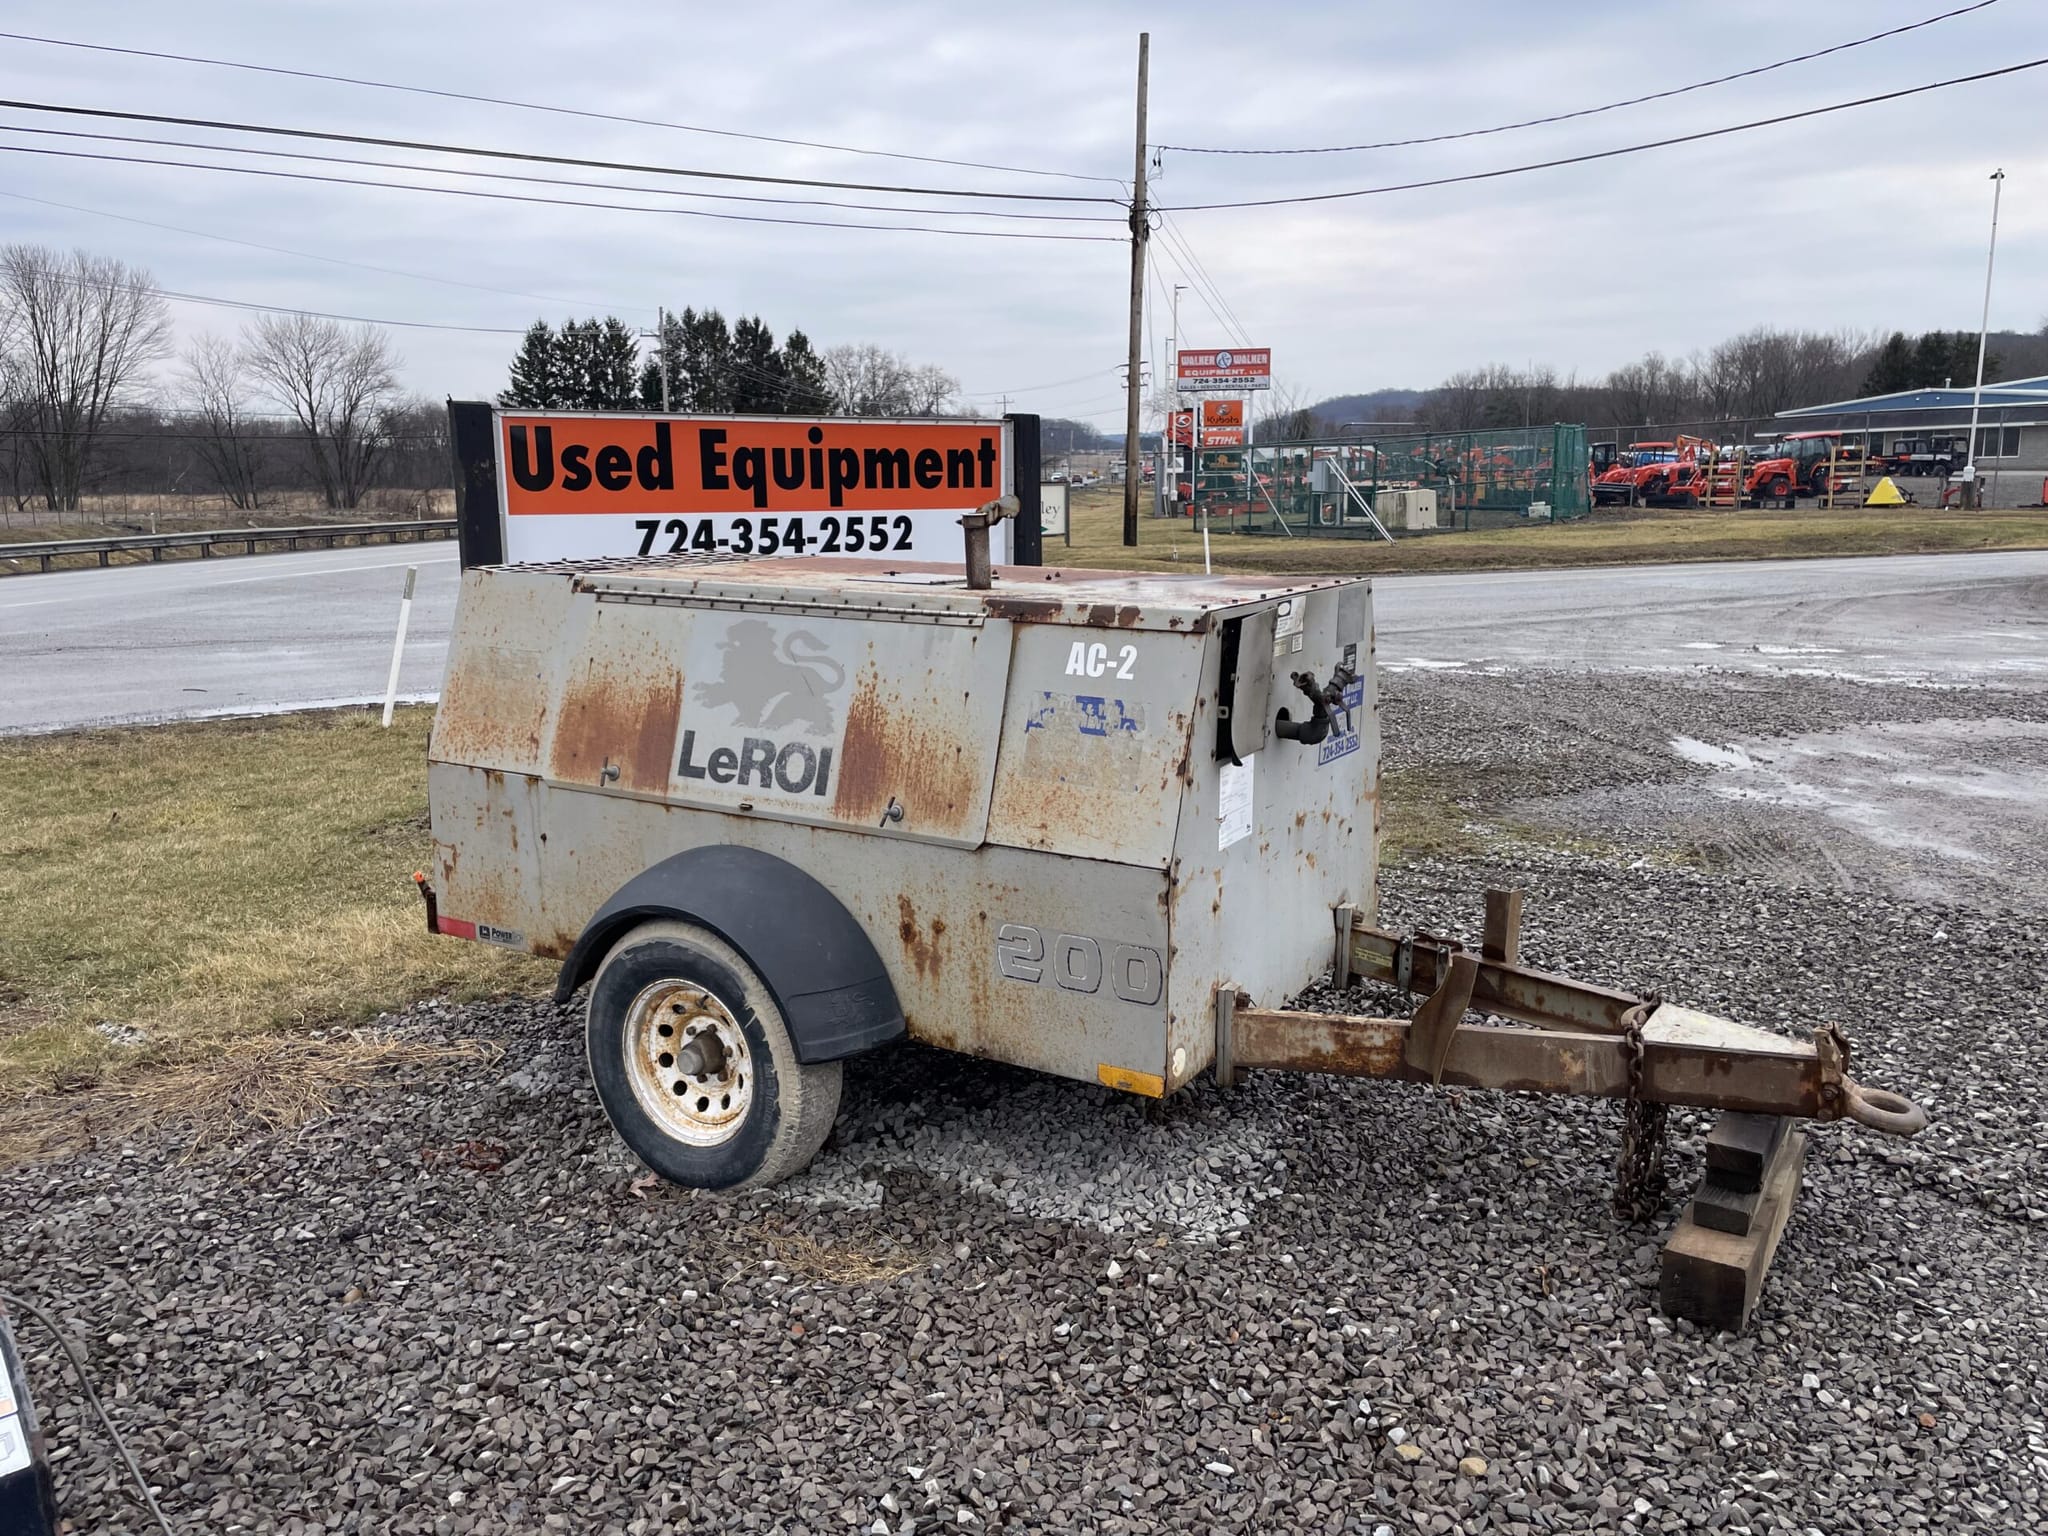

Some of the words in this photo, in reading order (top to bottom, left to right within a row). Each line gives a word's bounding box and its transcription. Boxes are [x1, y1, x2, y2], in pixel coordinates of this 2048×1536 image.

[1181, 355, 1215, 366] WALKER
[1217, 353, 1231, 368] &
[1233, 353, 1267, 365] WALKER
[1207, 416, 1239, 424] Kubota
[1206, 436, 1239, 445] STIHL
[510, 422, 674, 491] Used
[699, 426, 996, 508] Equipment
[1041, 500, 1060, 519] ley
[635, 515, 912, 556] 724-354-2552
[1065, 641, 1138, 680] AC-2
[677, 729, 833, 796] LeROI
[997, 923, 1163, 1005] 200
